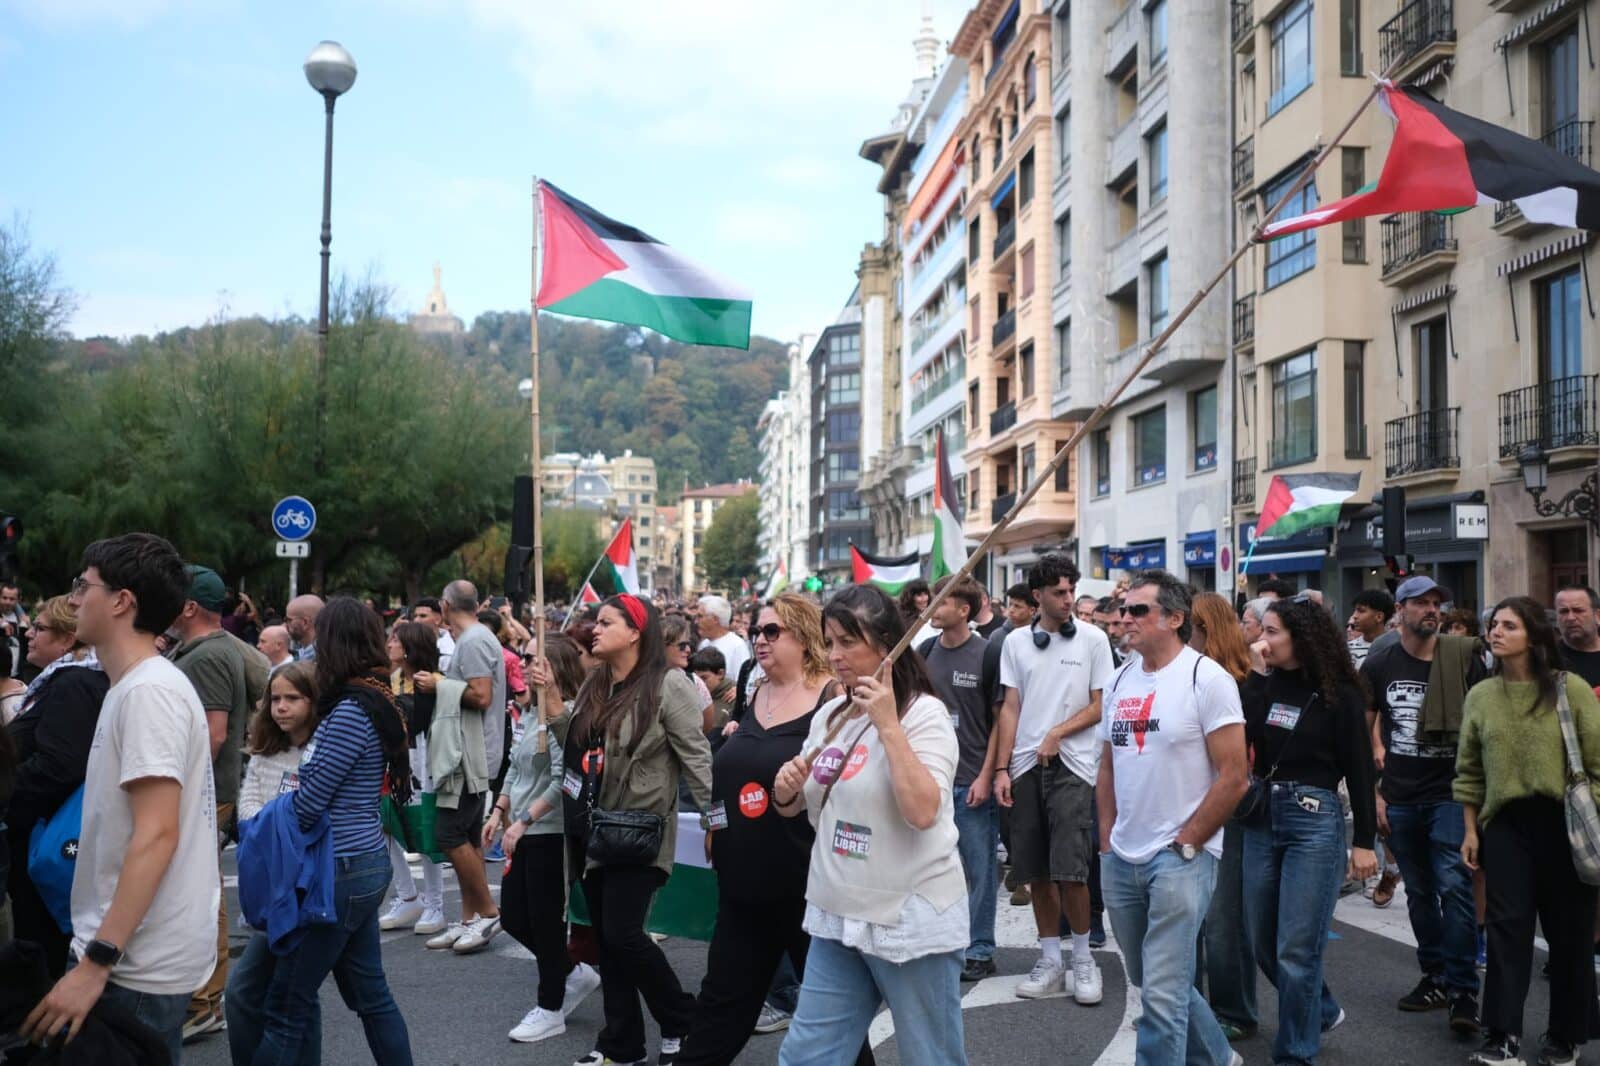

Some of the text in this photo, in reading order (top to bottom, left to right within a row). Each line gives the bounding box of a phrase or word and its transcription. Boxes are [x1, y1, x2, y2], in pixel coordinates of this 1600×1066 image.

[1459, 517, 1486, 526] REM
[740, 790, 764, 805] LAB
[834, 836, 869, 853] LIBRE!
